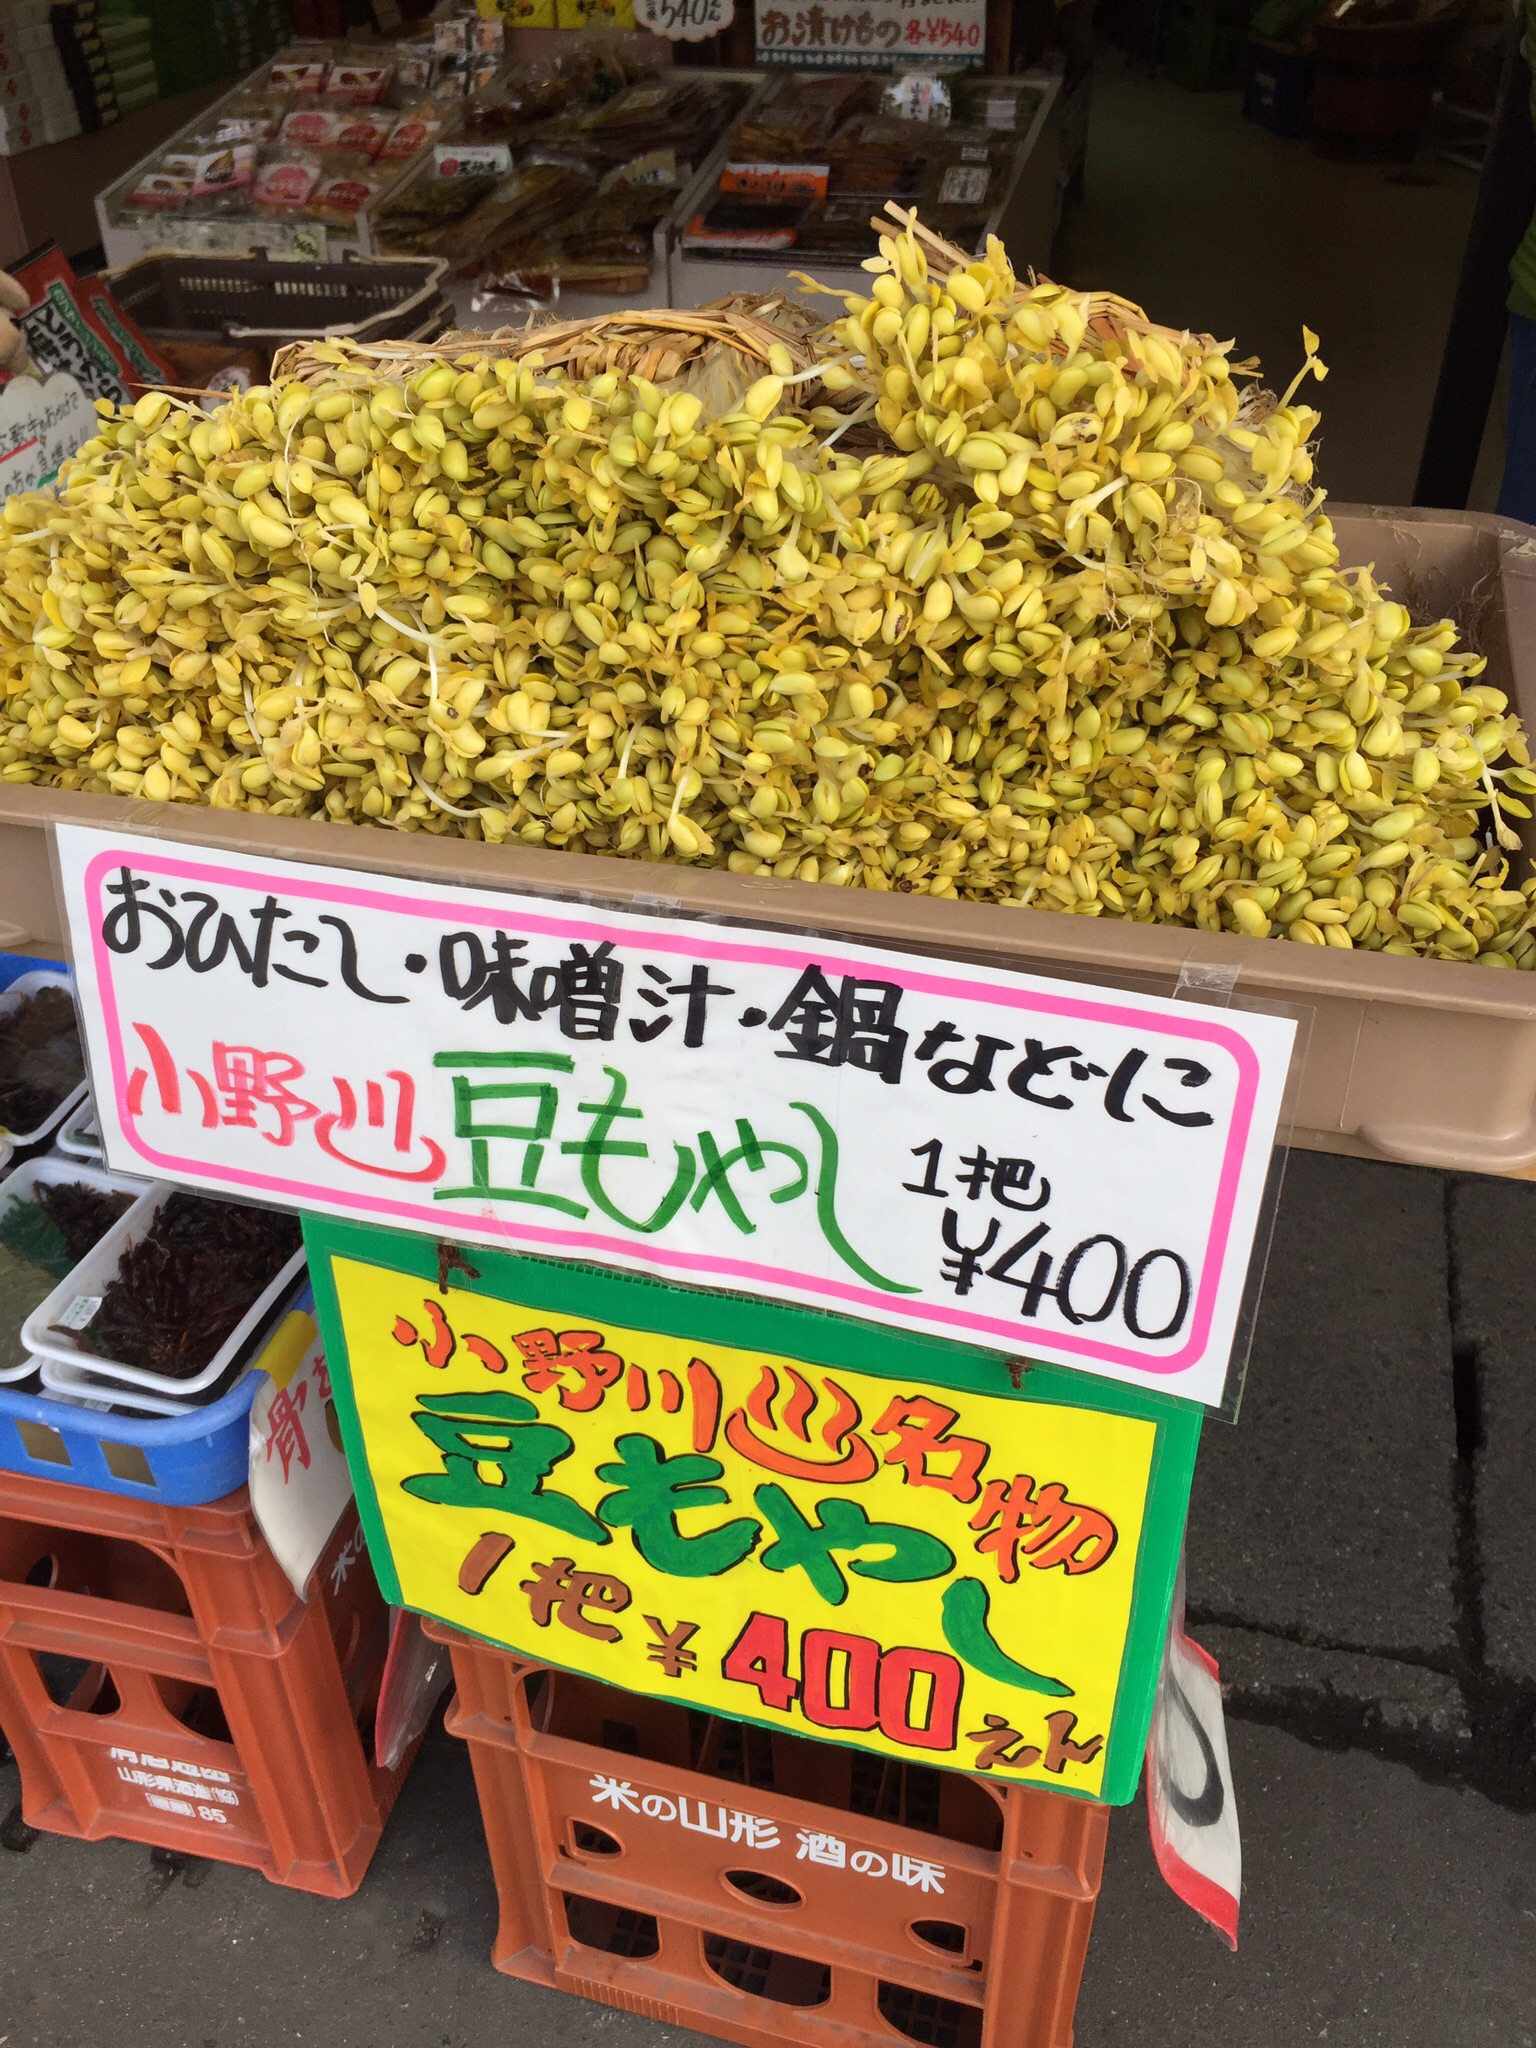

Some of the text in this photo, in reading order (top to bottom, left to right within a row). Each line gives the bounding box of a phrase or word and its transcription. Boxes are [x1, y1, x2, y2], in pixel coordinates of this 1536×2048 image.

[760, 4, 900, 48] お漬けもの
[433, 1051, 923, 1294] 豆もやし
[902, 1139, 1051, 1212] 1把
[940, 1208, 1192, 1339] ¥400
[401, 1391, 1075, 1698] 豆もやし
[197, 1805, 227, 1824] 85
[589, 1773, 946, 1894] 米の山形 酒の味
